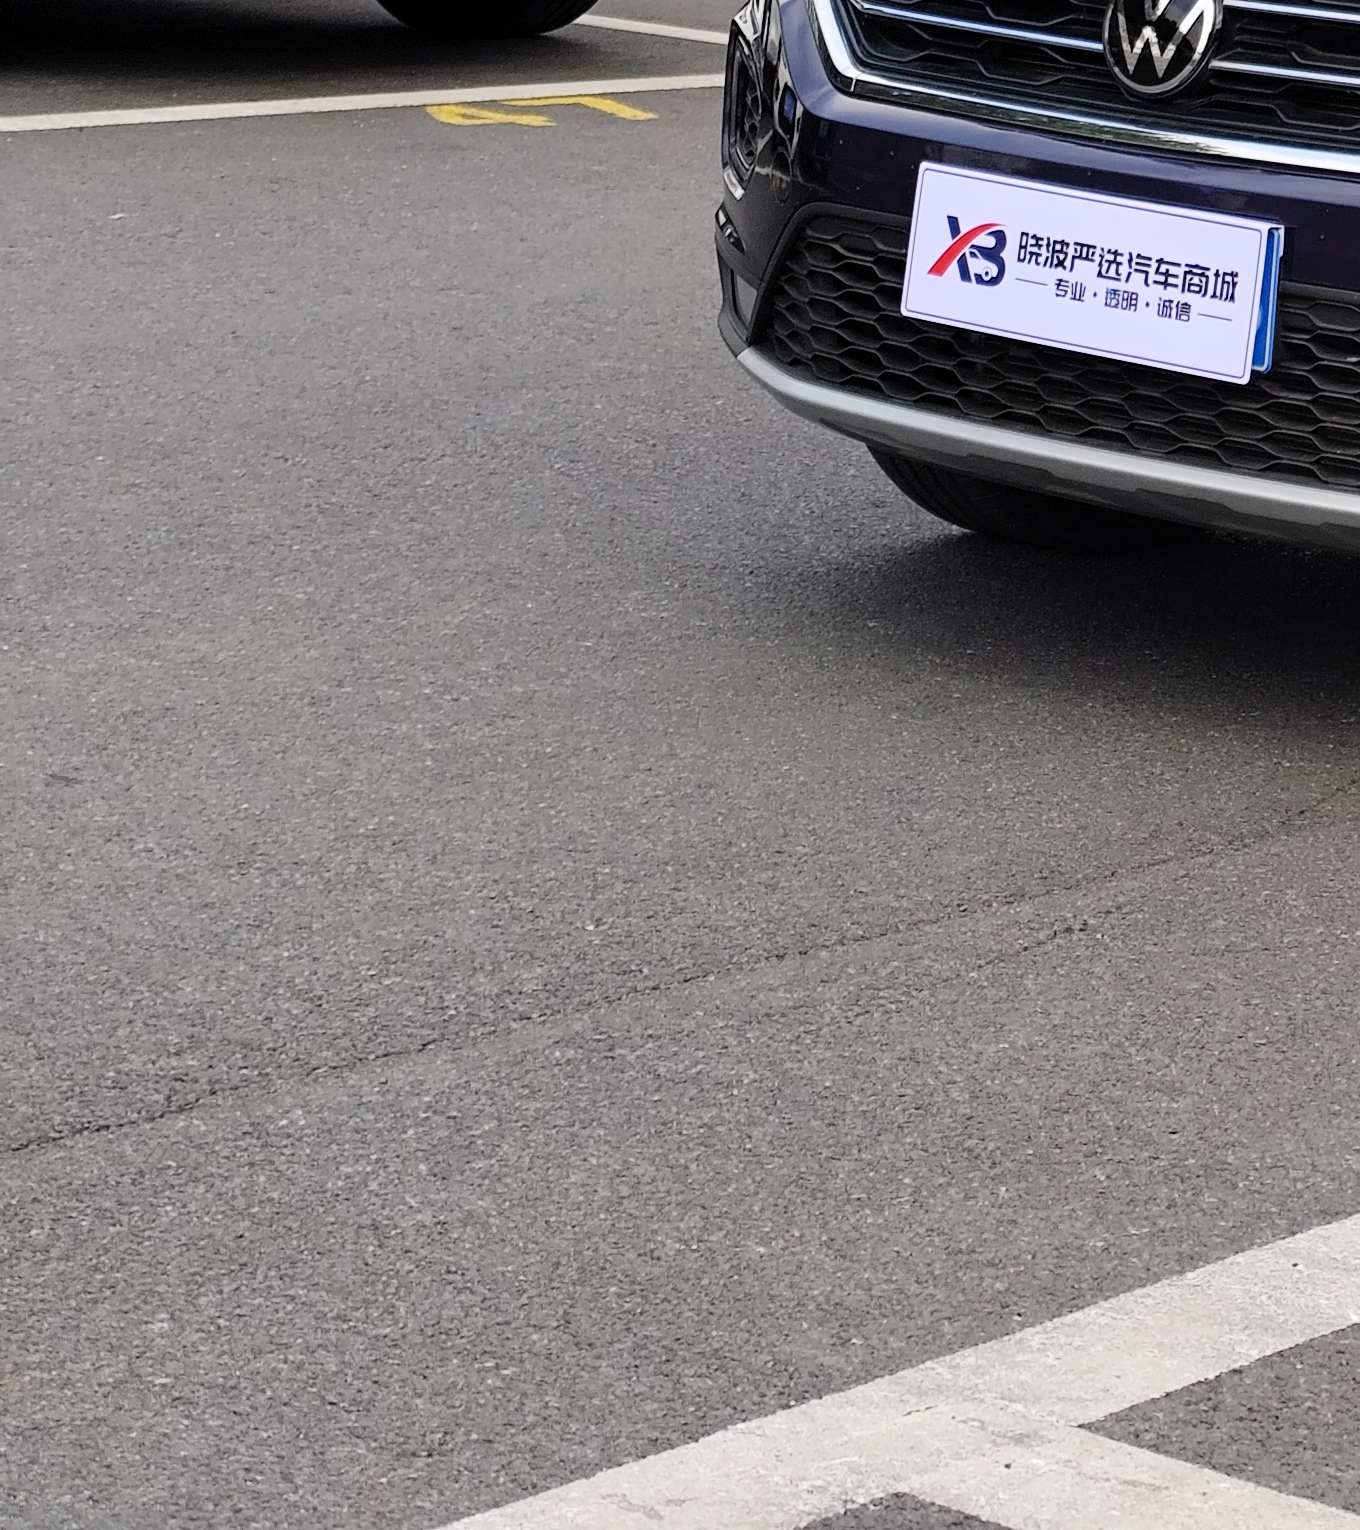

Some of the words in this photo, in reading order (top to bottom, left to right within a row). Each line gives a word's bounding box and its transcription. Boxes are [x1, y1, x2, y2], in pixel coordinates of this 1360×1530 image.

[1016, 231, 1240, 304] 晓波严选汽车商城
